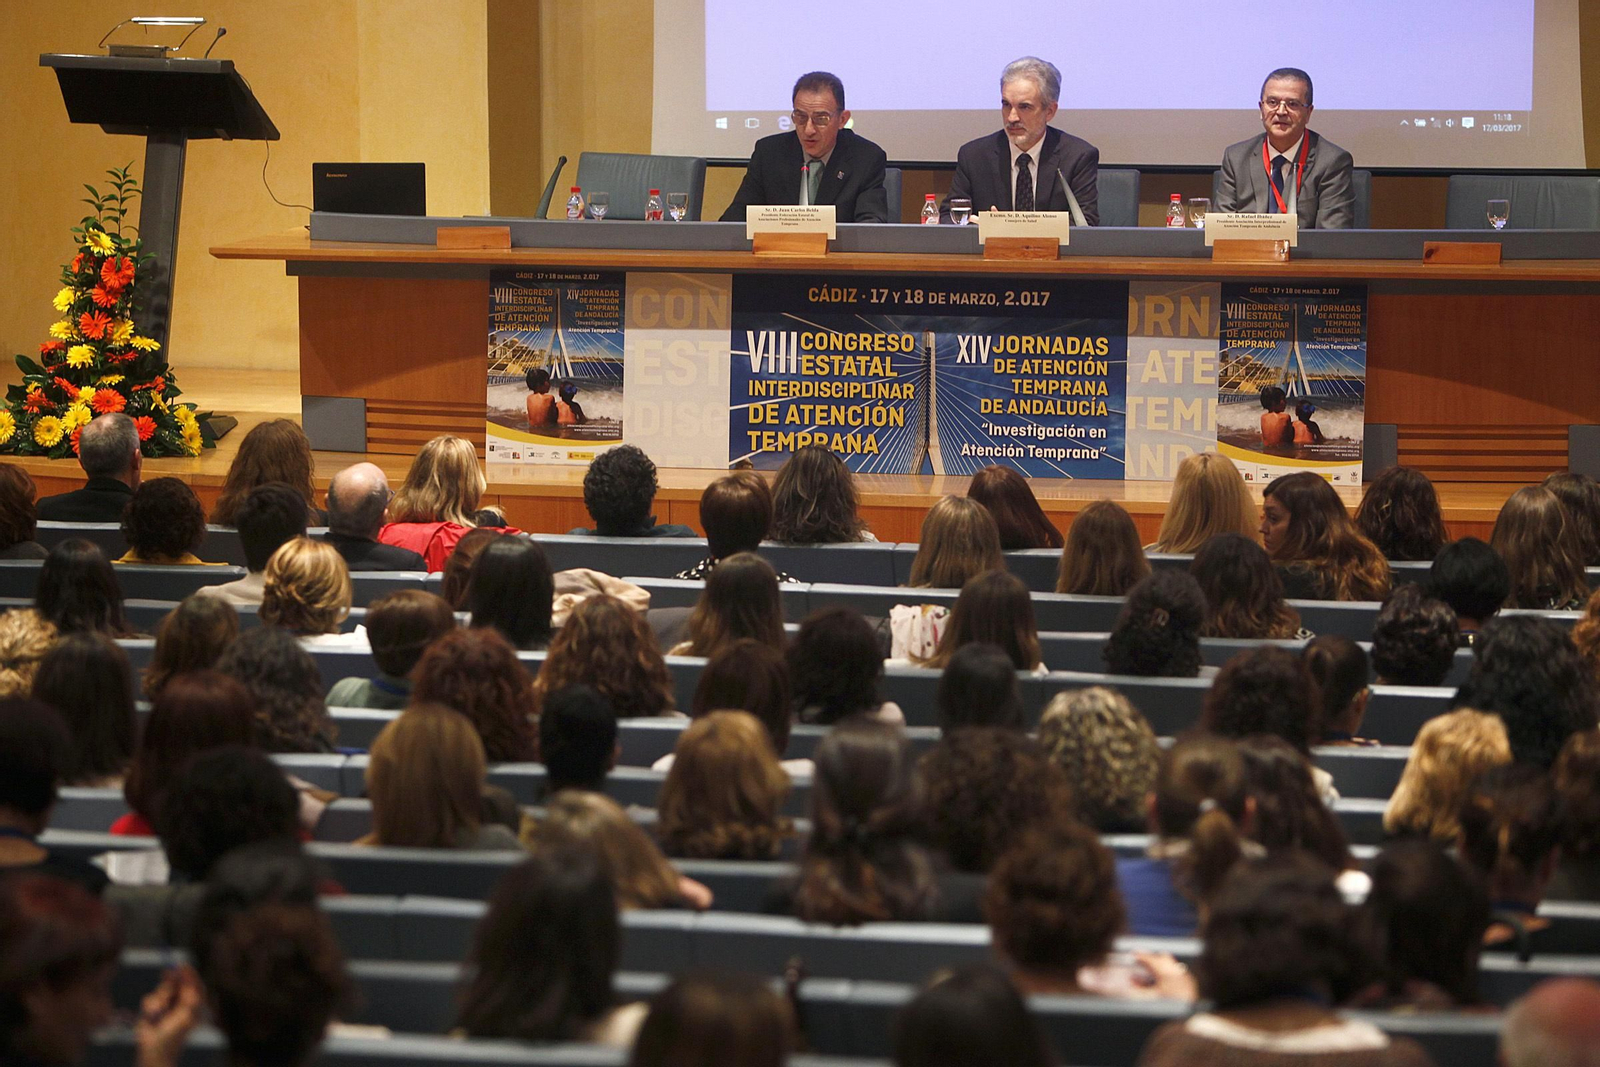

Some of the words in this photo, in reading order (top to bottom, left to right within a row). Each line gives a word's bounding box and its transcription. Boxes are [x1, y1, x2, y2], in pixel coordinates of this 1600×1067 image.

[1483, 124, 1521, 132] 17/03/2017
[494, 288, 513, 303] VIII
[513, 288, 553, 296] CONGRESO
[513, 297, 547, 305] ESTATAL
[567, 289, 579, 300] XIV
[580, 289, 619, 297] JORNADAS
[808, 284, 857, 302] CÁDIZ
[870, 288, 888, 303] 17
[893, 292, 900, 303] Y
[904, 289, 924, 304] 18
[928, 292, 946, 305] DE
[950, 293, 1000, 306] MARZO,
[1004, 291, 1050, 306] 2.017
[495, 305, 553, 313] INTERDISCIPLINAR
[632, 287, 729, 329] CON
[1226, 303, 1246, 319] VIII
[1305, 305, 1318, 315] XIV
[507, 313, 549, 322] ATENCIÓN
[1246, 312, 1283, 320] ESTATAL
[494, 323, 540, 332] TEMPRANA
[1226, 321, 1289, 329] INTERDISCIPLINAR
[1226, 330, 1238, 338] DE
[1240, 329, 1286, 339] ATENCIÓN
[746, 330, 798, 373] VIII
[800, 332, 915, 352] CONGRESO
[956, 335, 992, 364] XIV
[993, 336, 1109, 355] JORNADAS
[1226, 340, 1276, 349] TEMPRANA
[634, 340, 729, 386] EST
[802, 355, 898, 377] ESTATAL
[994, 359, 1017, 374] DE
[1020, 356, 1108, 376] ATENCIÓN
[1140, 350, 1216, 384] ATE
[748, 380, 915, 400] INTERDISCIPLINAR
[1012, 379, 1108, 396] TEMPRANA
[748, 404, 779, 424] DE
[785, 400, 904, 427] ATENCIÓN
[980, 399, 1002, 414] DE
[1007, 397, 1108, 416] ANDALUCÍA
[1089, 427, 1106, 438] en
[961, 443, 1024, 457] Atención
